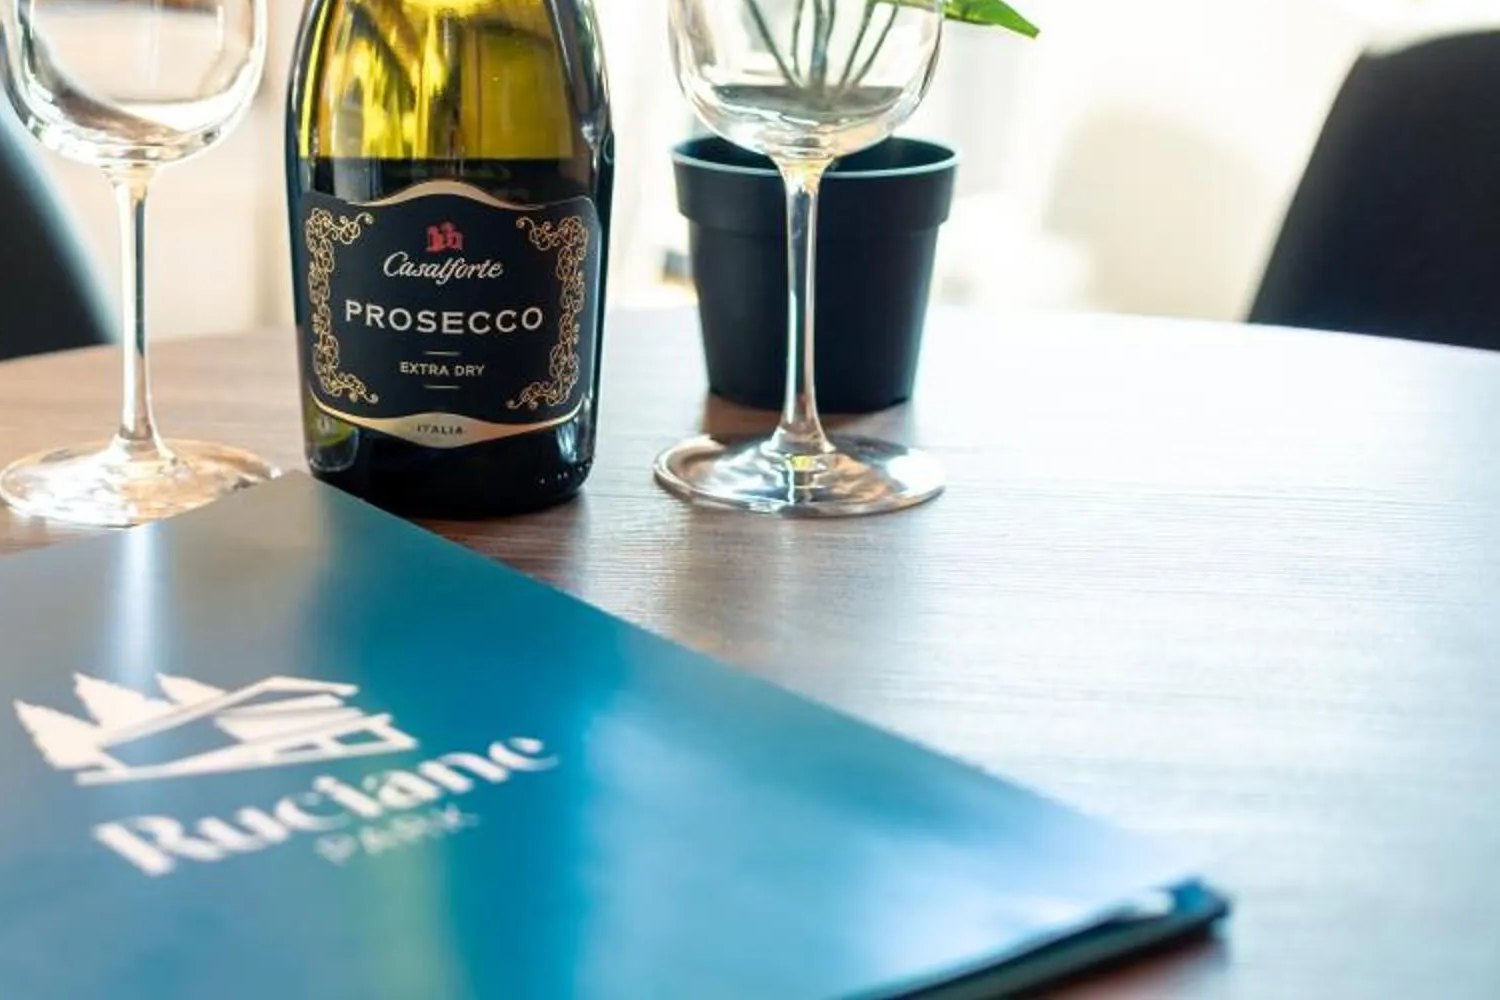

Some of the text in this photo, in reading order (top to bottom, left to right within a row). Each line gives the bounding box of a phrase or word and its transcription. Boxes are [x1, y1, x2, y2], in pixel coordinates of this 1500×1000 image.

[382, 250, 504, 285] Casalforte
[344, 299, 544, 335] PROSECCO
[400, 361, 485, 377] EXTRA DRY
[417, 422, 464, 436] ITALIA
[94, 736, 559, 876] Ruciane
